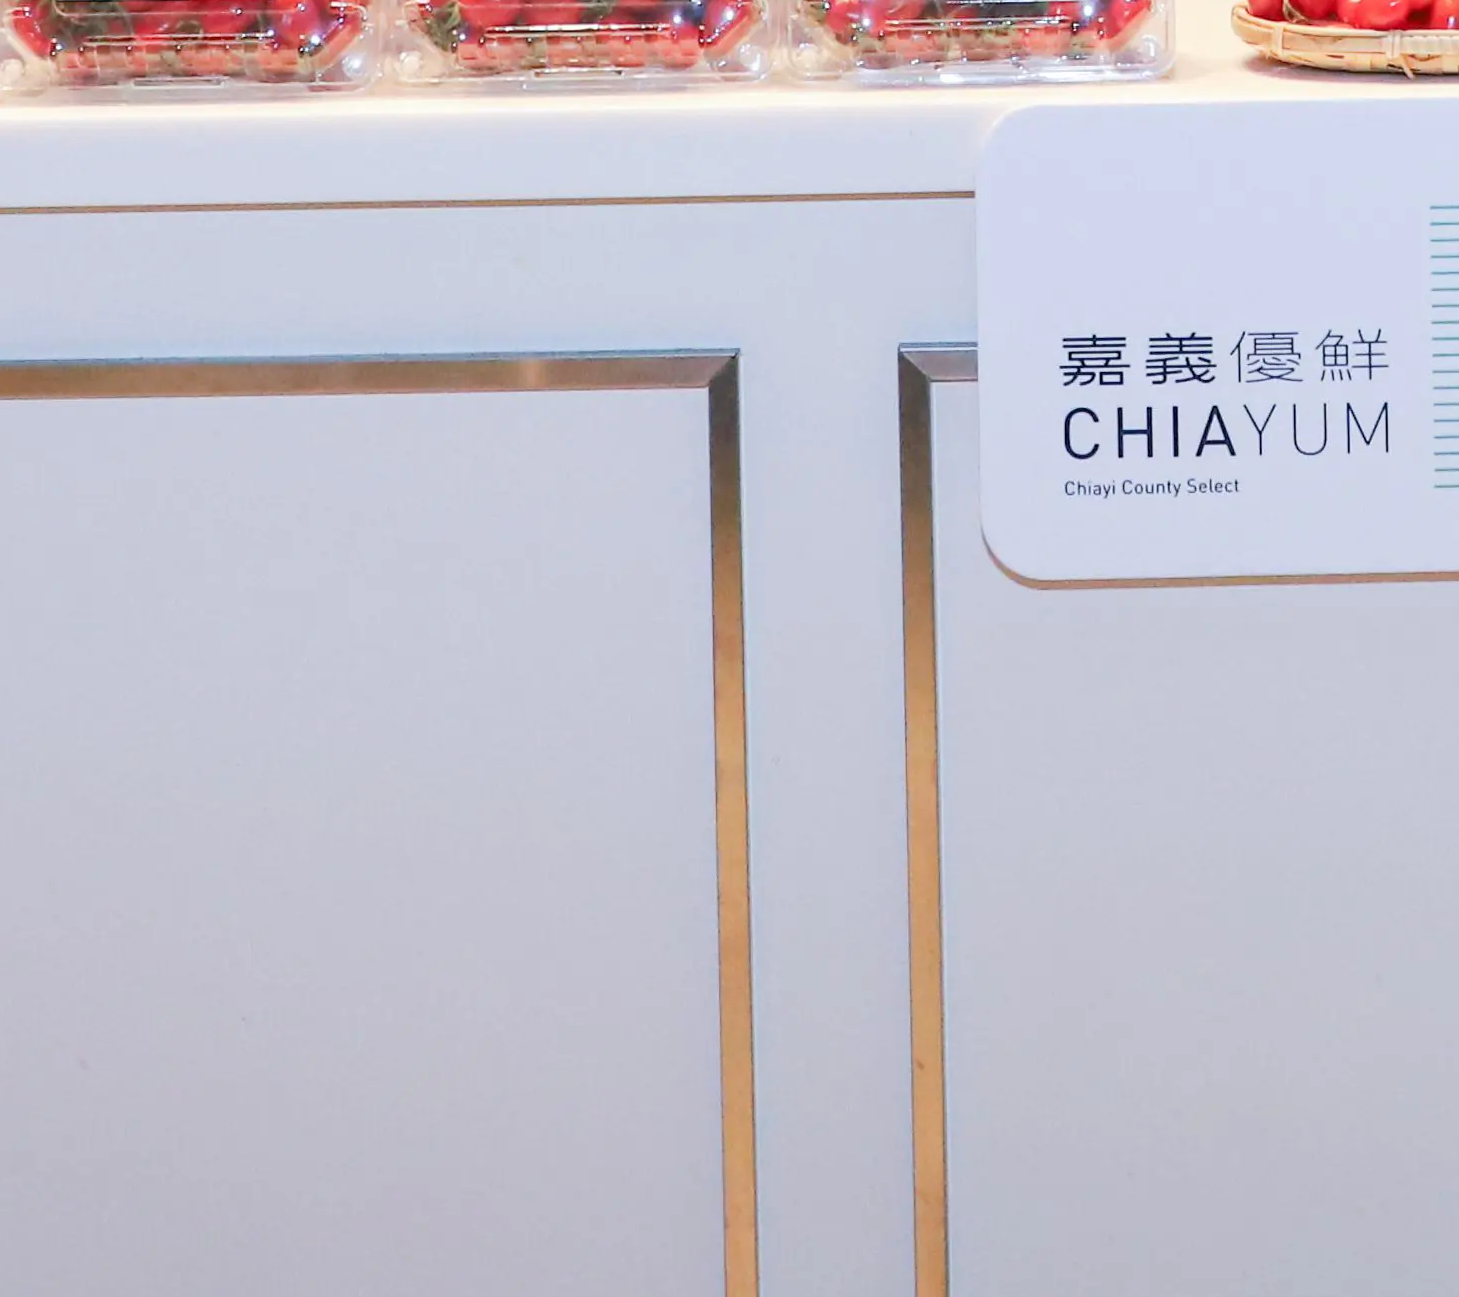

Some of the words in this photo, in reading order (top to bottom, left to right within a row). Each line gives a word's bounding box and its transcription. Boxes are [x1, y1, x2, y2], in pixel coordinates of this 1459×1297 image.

[1059, 328, 1390, 387] 嘉義優鮮
[1063, 402, 1390, 460] CHIAYUM
[1063, 480, 1116, 500] Chiayi
[1121, 479, 1182, 498] County
[1186, 478, 1240, 495] Select
